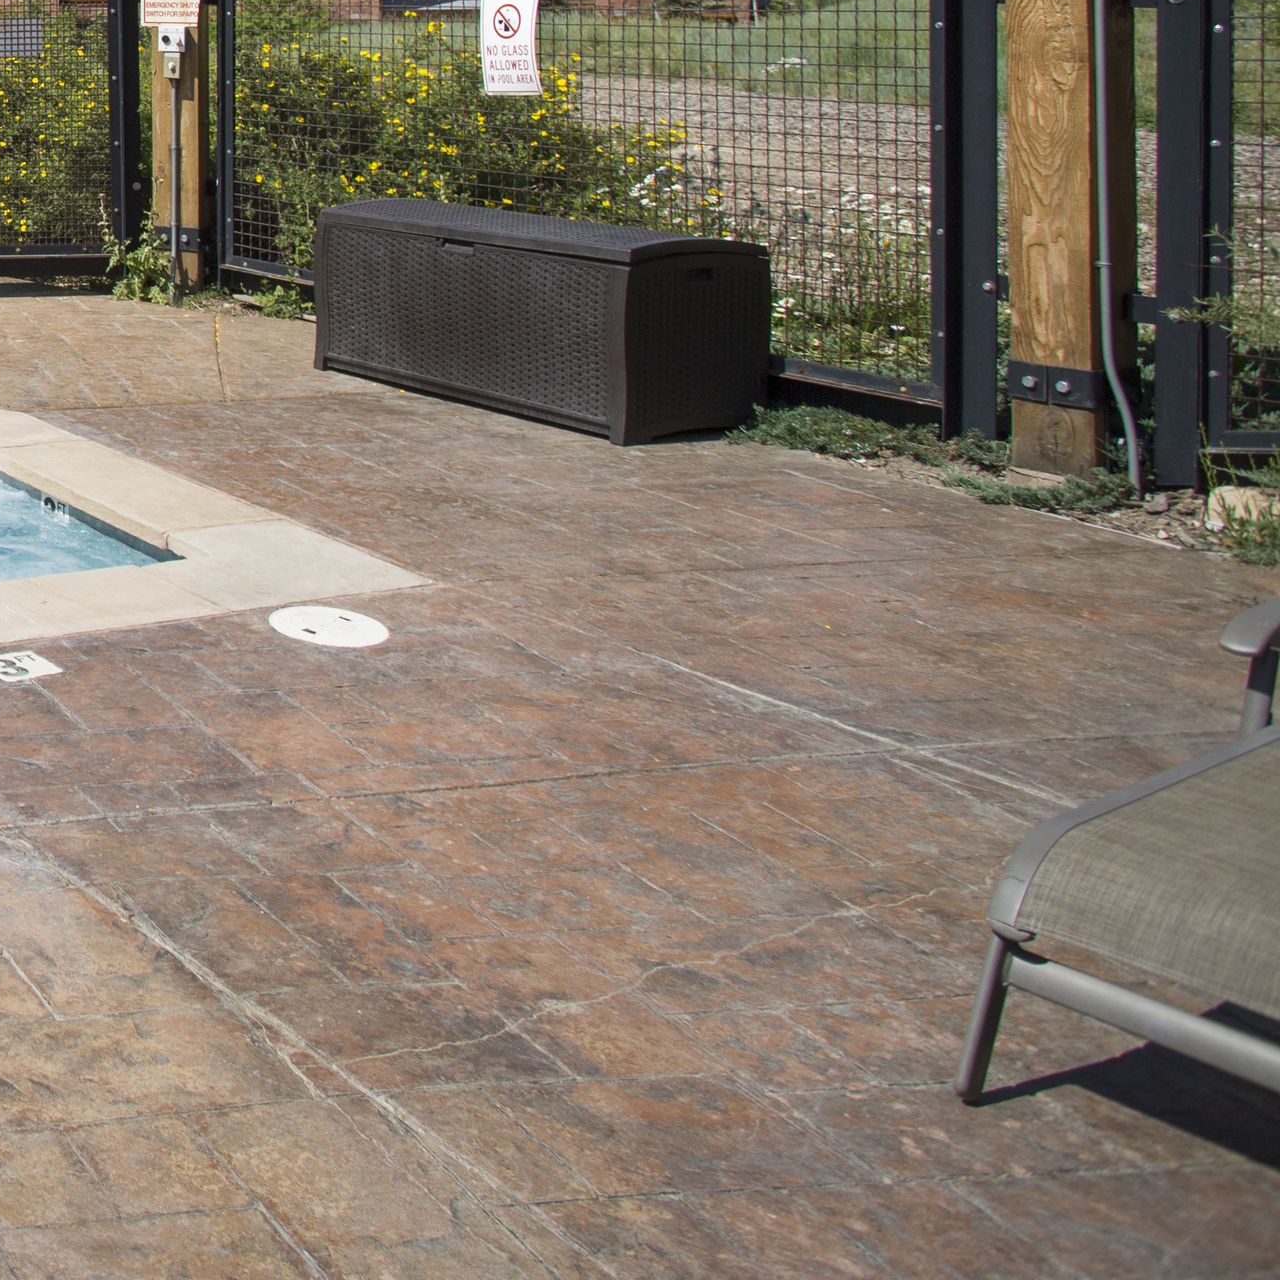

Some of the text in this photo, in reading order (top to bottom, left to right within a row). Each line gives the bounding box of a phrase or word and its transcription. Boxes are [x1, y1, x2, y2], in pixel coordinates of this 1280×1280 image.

[486, 45, 529, 56] NO GLASS
[489, 59, 529, 71] ALLOWED
[488, 73, 534, 84] IN POOL AREA
[14, 654, 36, 663] FT
